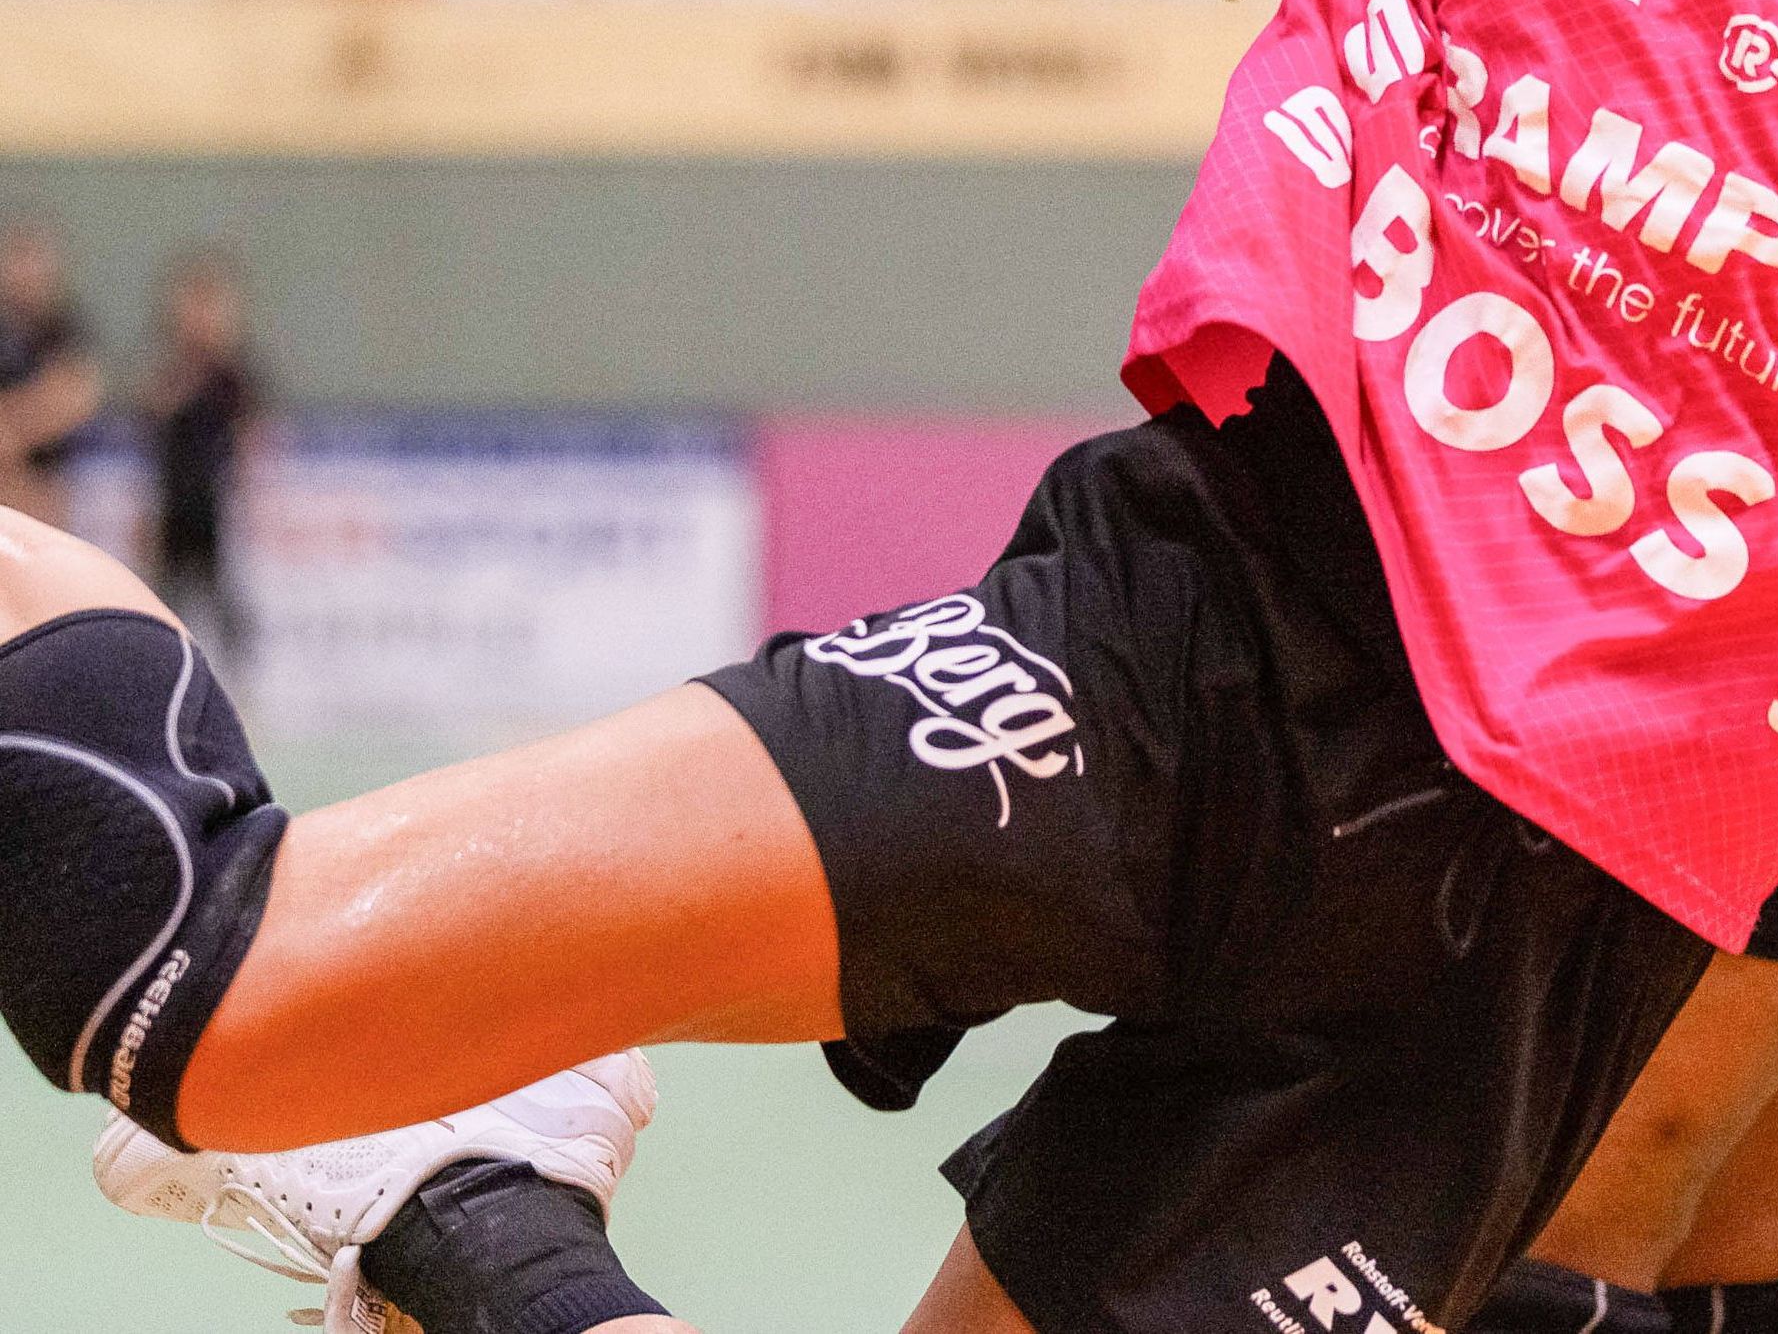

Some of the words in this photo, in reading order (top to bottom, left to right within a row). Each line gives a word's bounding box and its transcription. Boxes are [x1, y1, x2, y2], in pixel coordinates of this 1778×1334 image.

[1568, 246, 1655, 323] the
[1351, 163, 1777, 603] BOSS
[803, 593, 1076, 779] Berg
